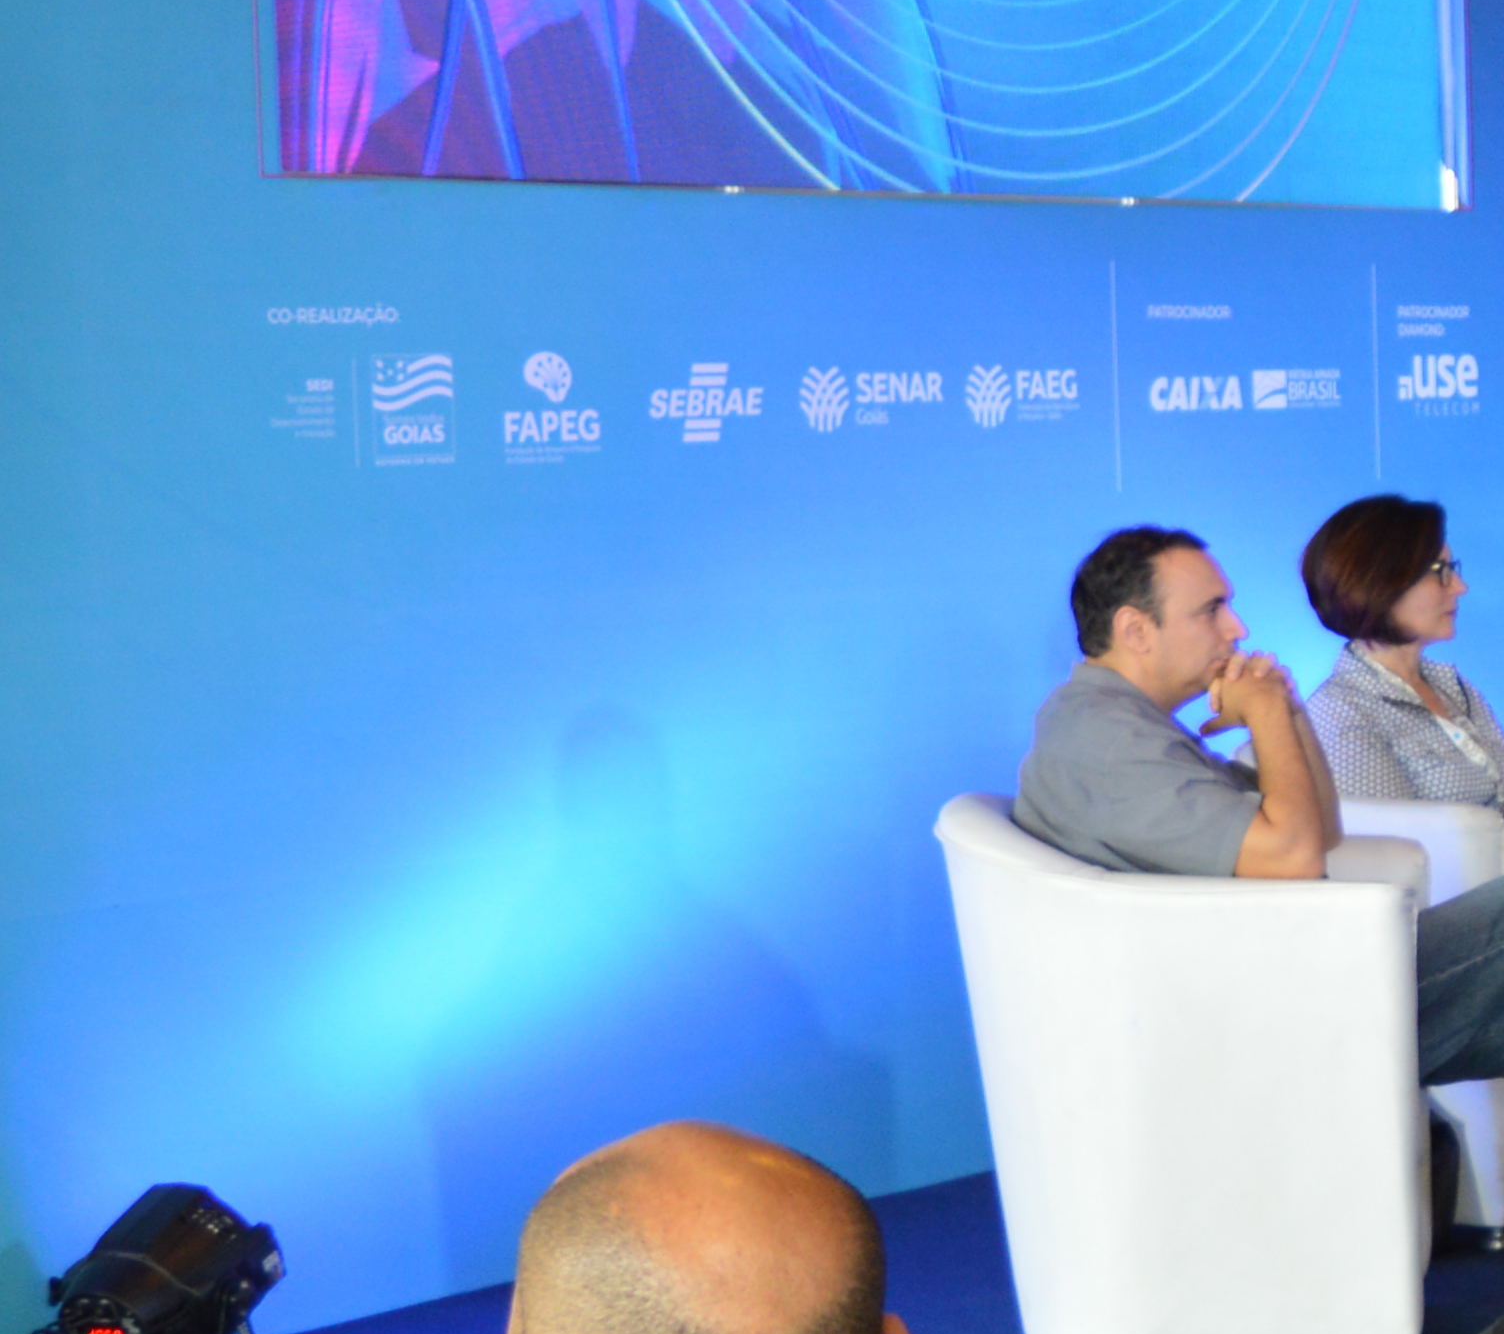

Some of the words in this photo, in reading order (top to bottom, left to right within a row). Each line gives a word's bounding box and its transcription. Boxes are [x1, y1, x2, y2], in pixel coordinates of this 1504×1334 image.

[855, 372, 944, 404] SENAR
[1016, 369, 1078, 401] FAEG
[1287, 380, 1342, 400] BRASIL
[1412, 353, 1480, 399] use
[648, 386, 764, 419] SEBRAE
[1150, 375, 1243, 411] CAIXA
[1415, 401, 1481, 416] TELECOM
[504, 409, 602, 443] FAPEG
